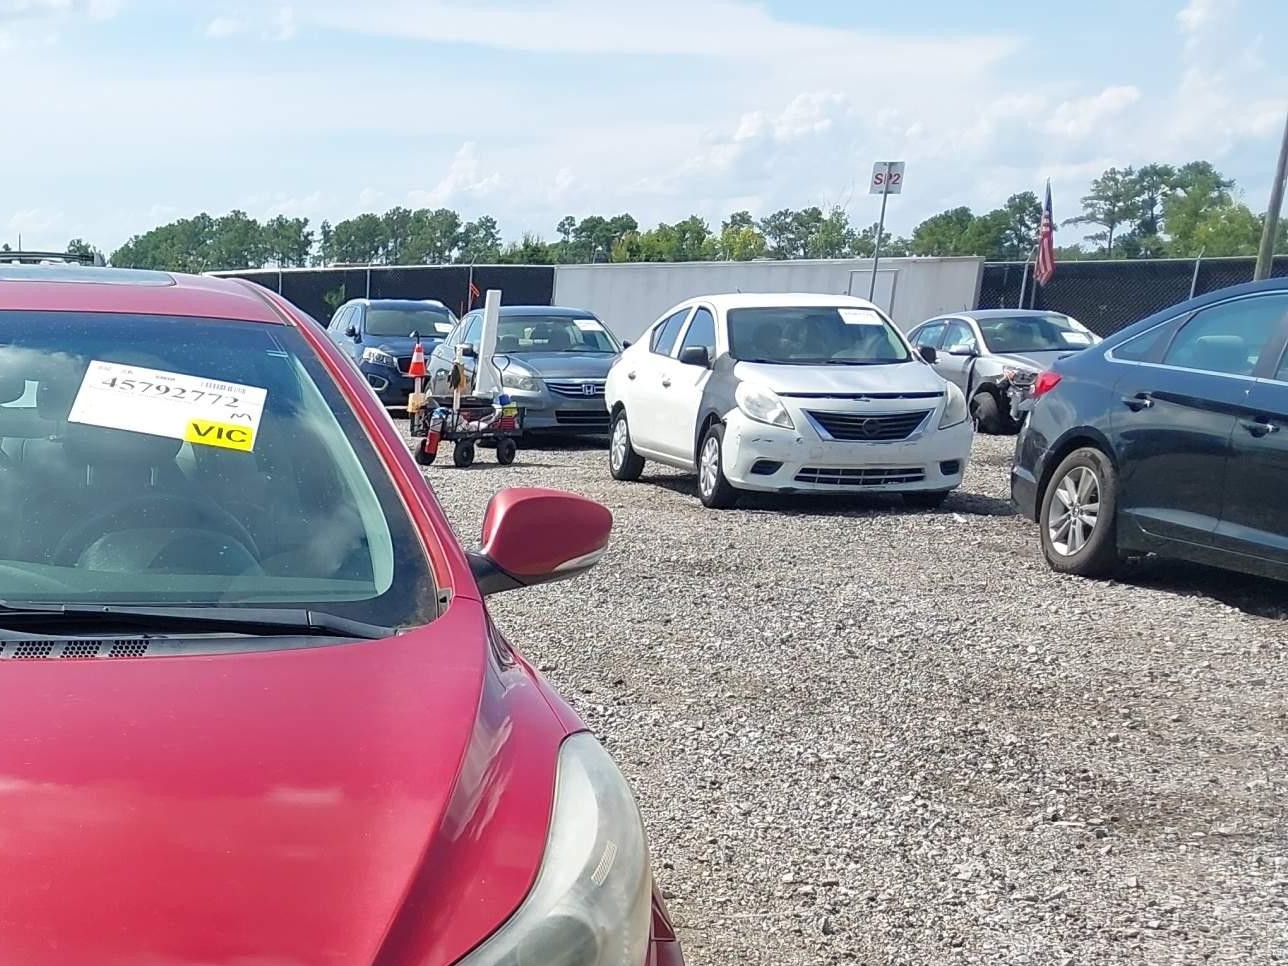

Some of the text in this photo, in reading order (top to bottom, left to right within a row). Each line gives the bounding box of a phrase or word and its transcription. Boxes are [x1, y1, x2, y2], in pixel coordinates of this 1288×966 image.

[873, 172, 901, 185] SP2
[101, 376, 240, 408] 45792772
[192, 423, 248, 443] VIC
